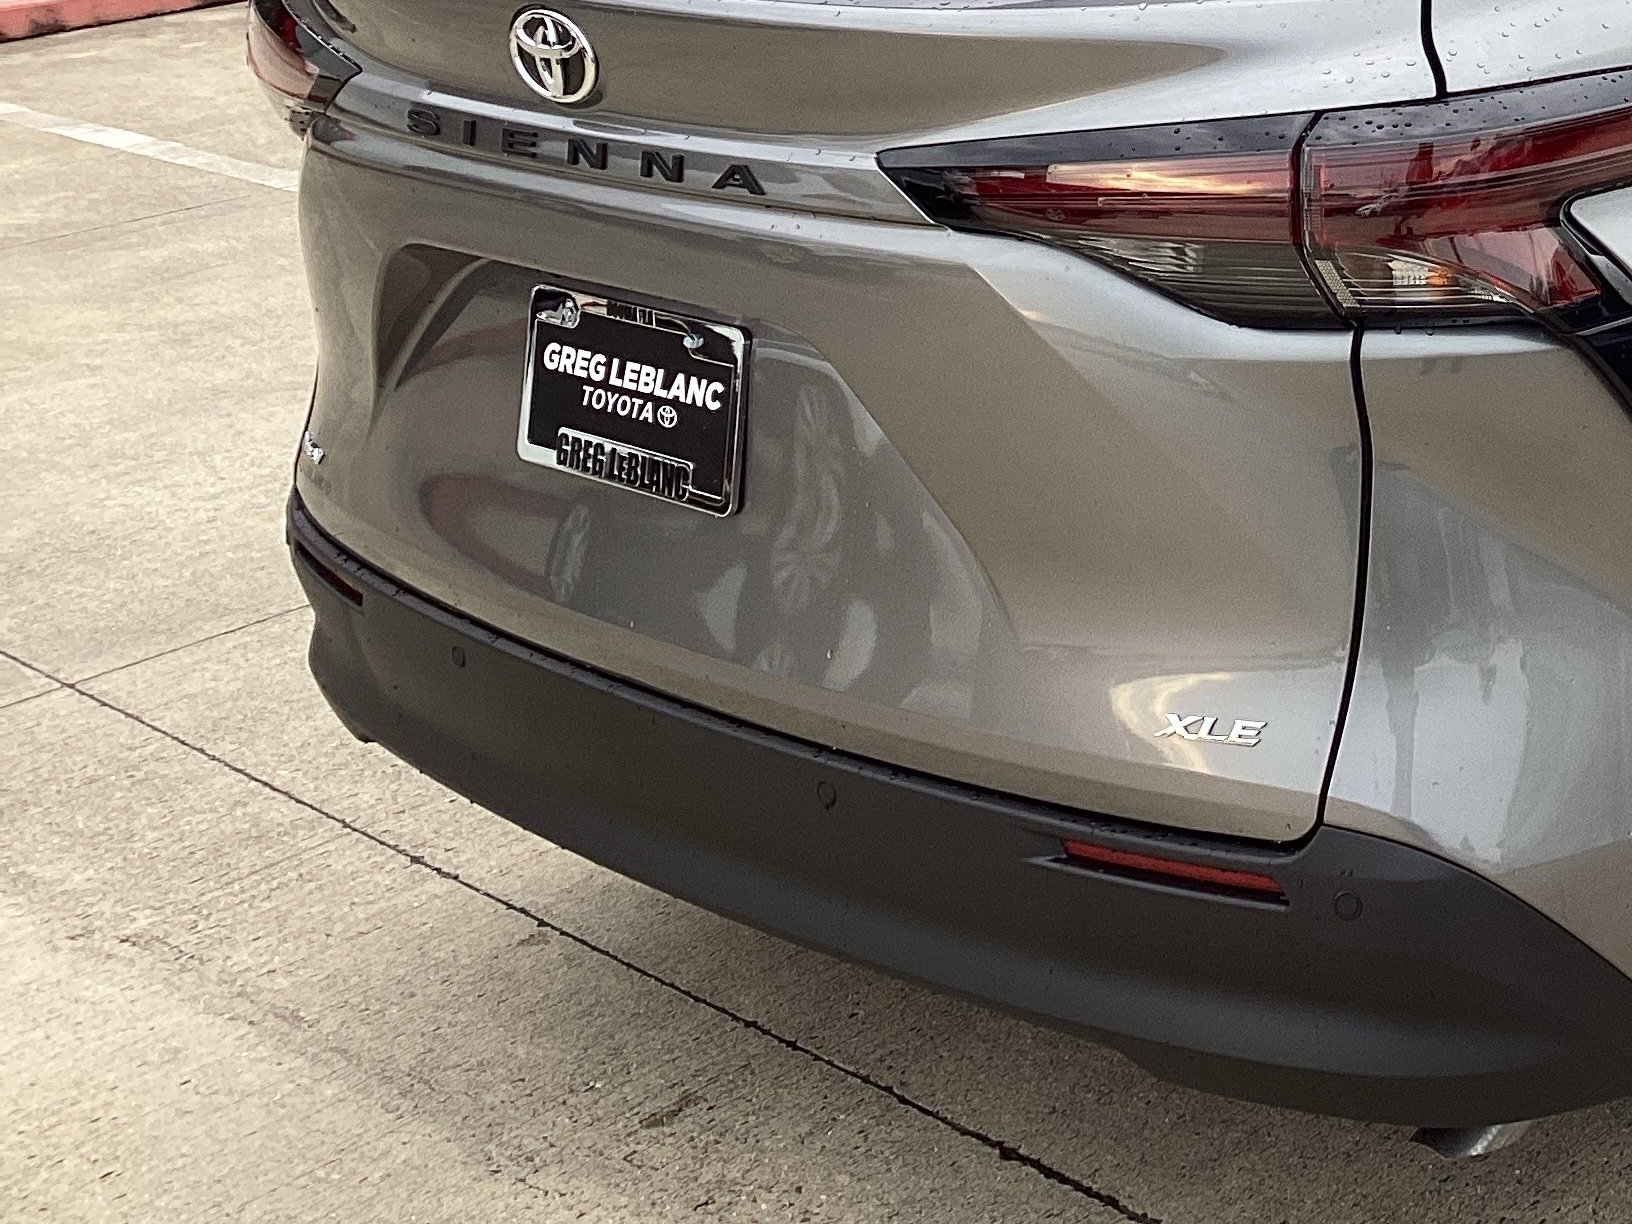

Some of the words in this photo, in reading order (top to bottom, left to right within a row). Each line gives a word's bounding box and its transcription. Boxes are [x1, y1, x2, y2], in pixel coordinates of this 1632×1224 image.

[405, 107, 766, 196] SIENNA
[543, 341, 607, 383] GREG
[608, 357, 725, 411] LEBLANC
[582, 385, 654, 424] TOYOTA
[555, 431, 606, 478] GREG
[1153, 711, 1268, 748] XLE
